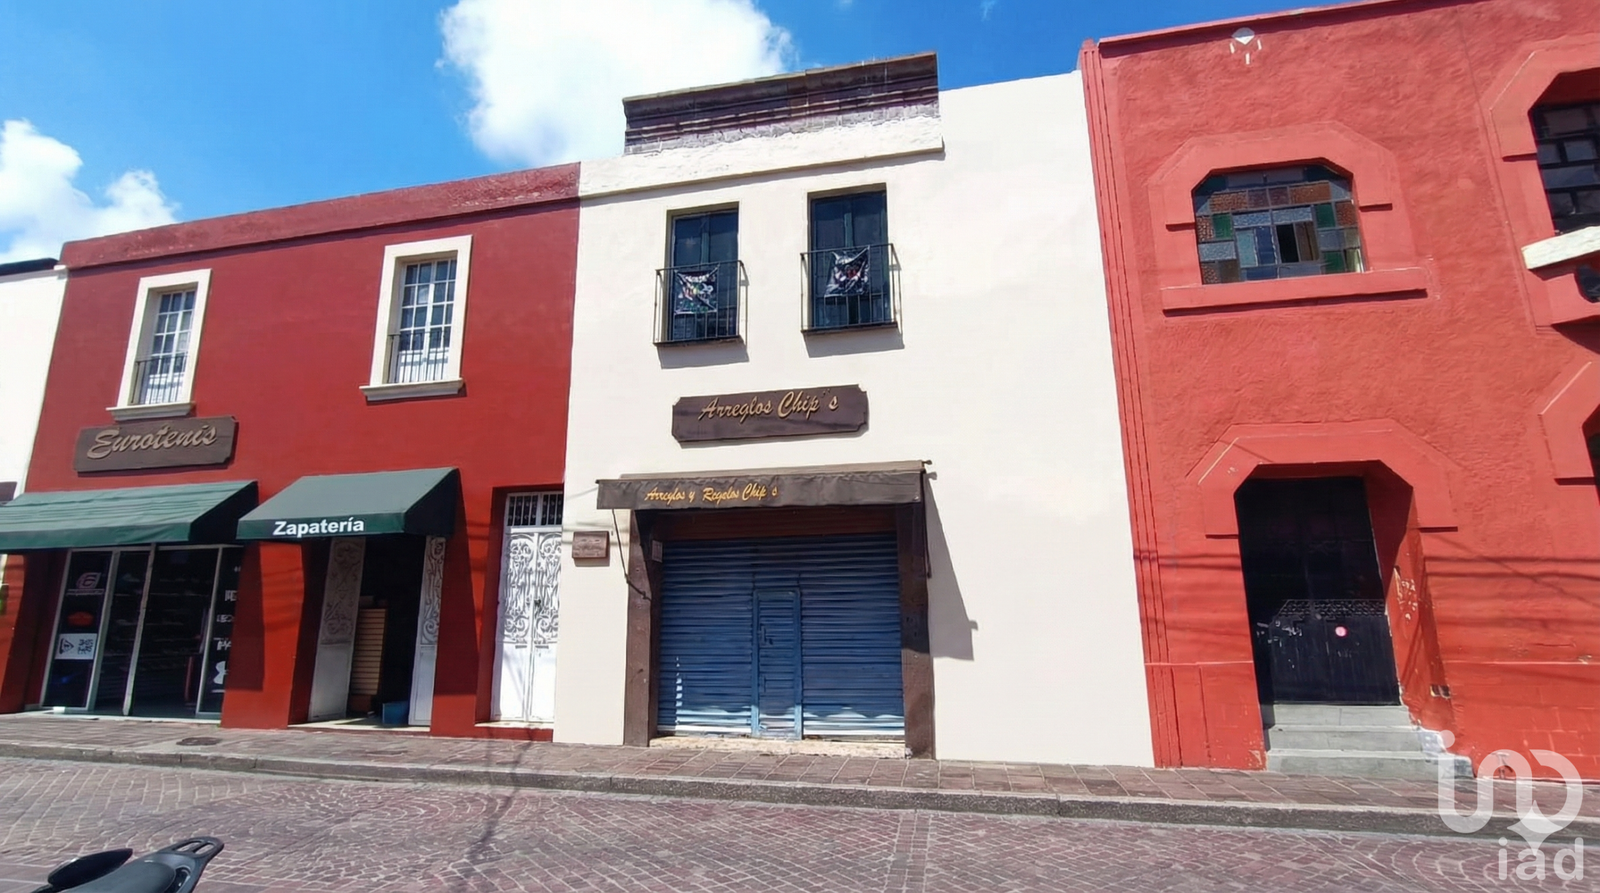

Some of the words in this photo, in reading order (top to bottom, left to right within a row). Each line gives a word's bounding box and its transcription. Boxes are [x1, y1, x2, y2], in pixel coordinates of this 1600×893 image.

[697, 396, 773, 424] Arreglos
[86, 424, 218, 460] Eurotenis
[688, 490, 696, 503] y
[272, 516, 365, 538] Zapatería
